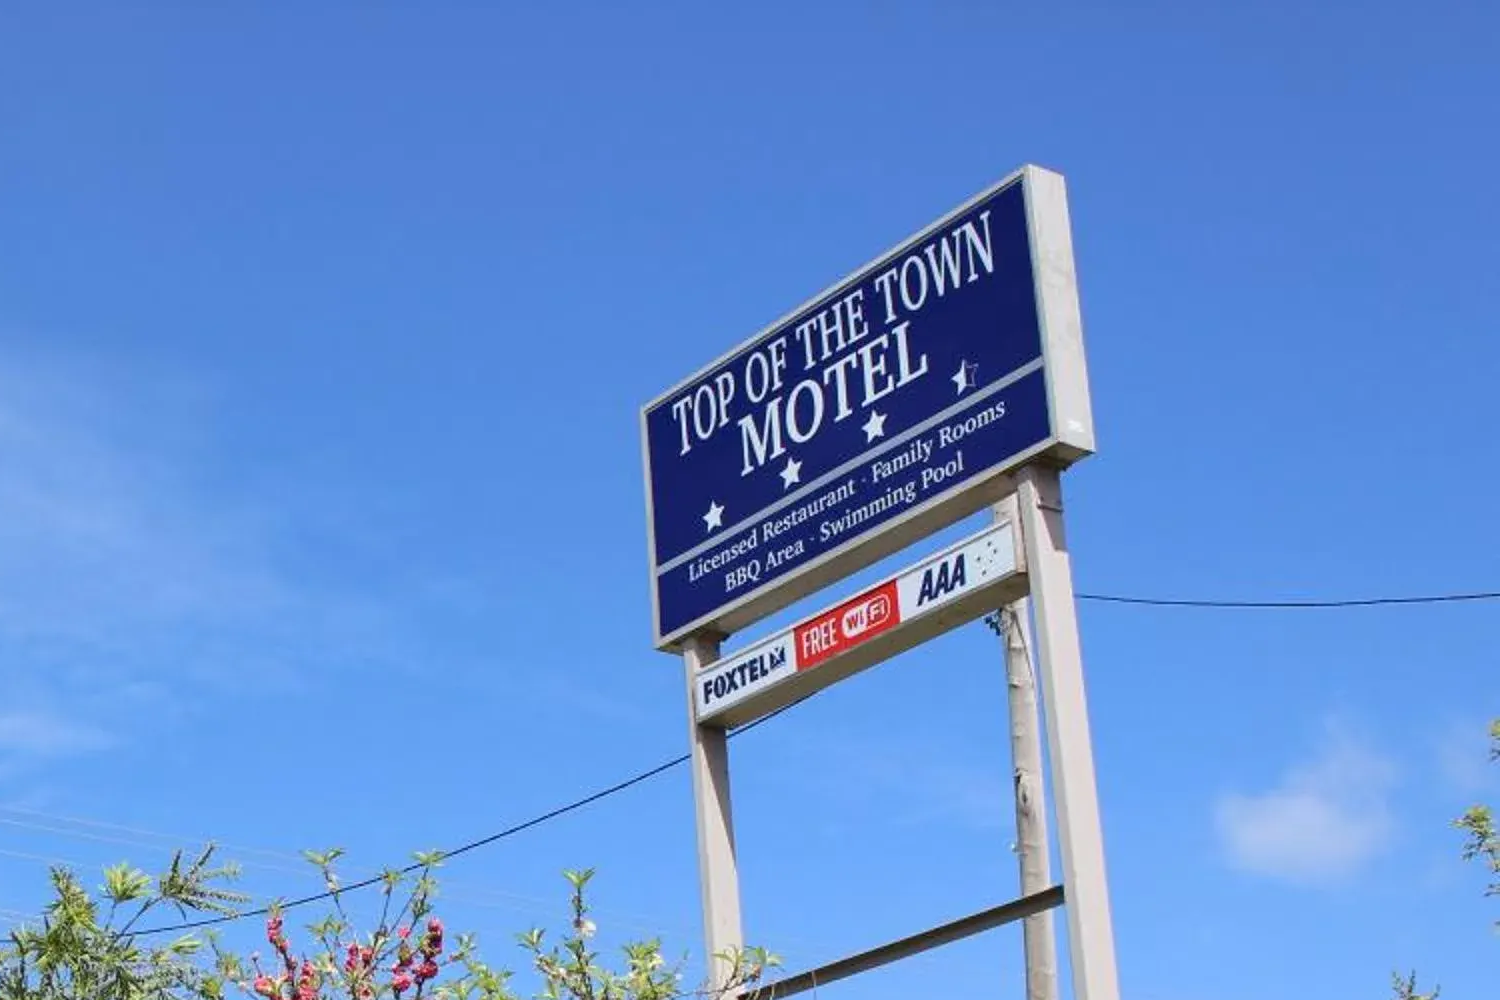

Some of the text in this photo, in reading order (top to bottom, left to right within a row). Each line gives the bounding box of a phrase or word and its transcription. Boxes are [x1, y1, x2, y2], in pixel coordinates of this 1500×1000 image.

[672, 210, 995, 456] TOP OF THE TOWN
[737, 321, 928, 477] MOTEL
[688, 401, 1006, 582] Licensed Restaurant Family Rooms
[725, 450, 964, 592] BBQ Area Swimming Pool
[802, 617, 838, 659] FREE
[917, 553, 966, 607] AAA
[703, 654, 769, 704] FOXTEL
